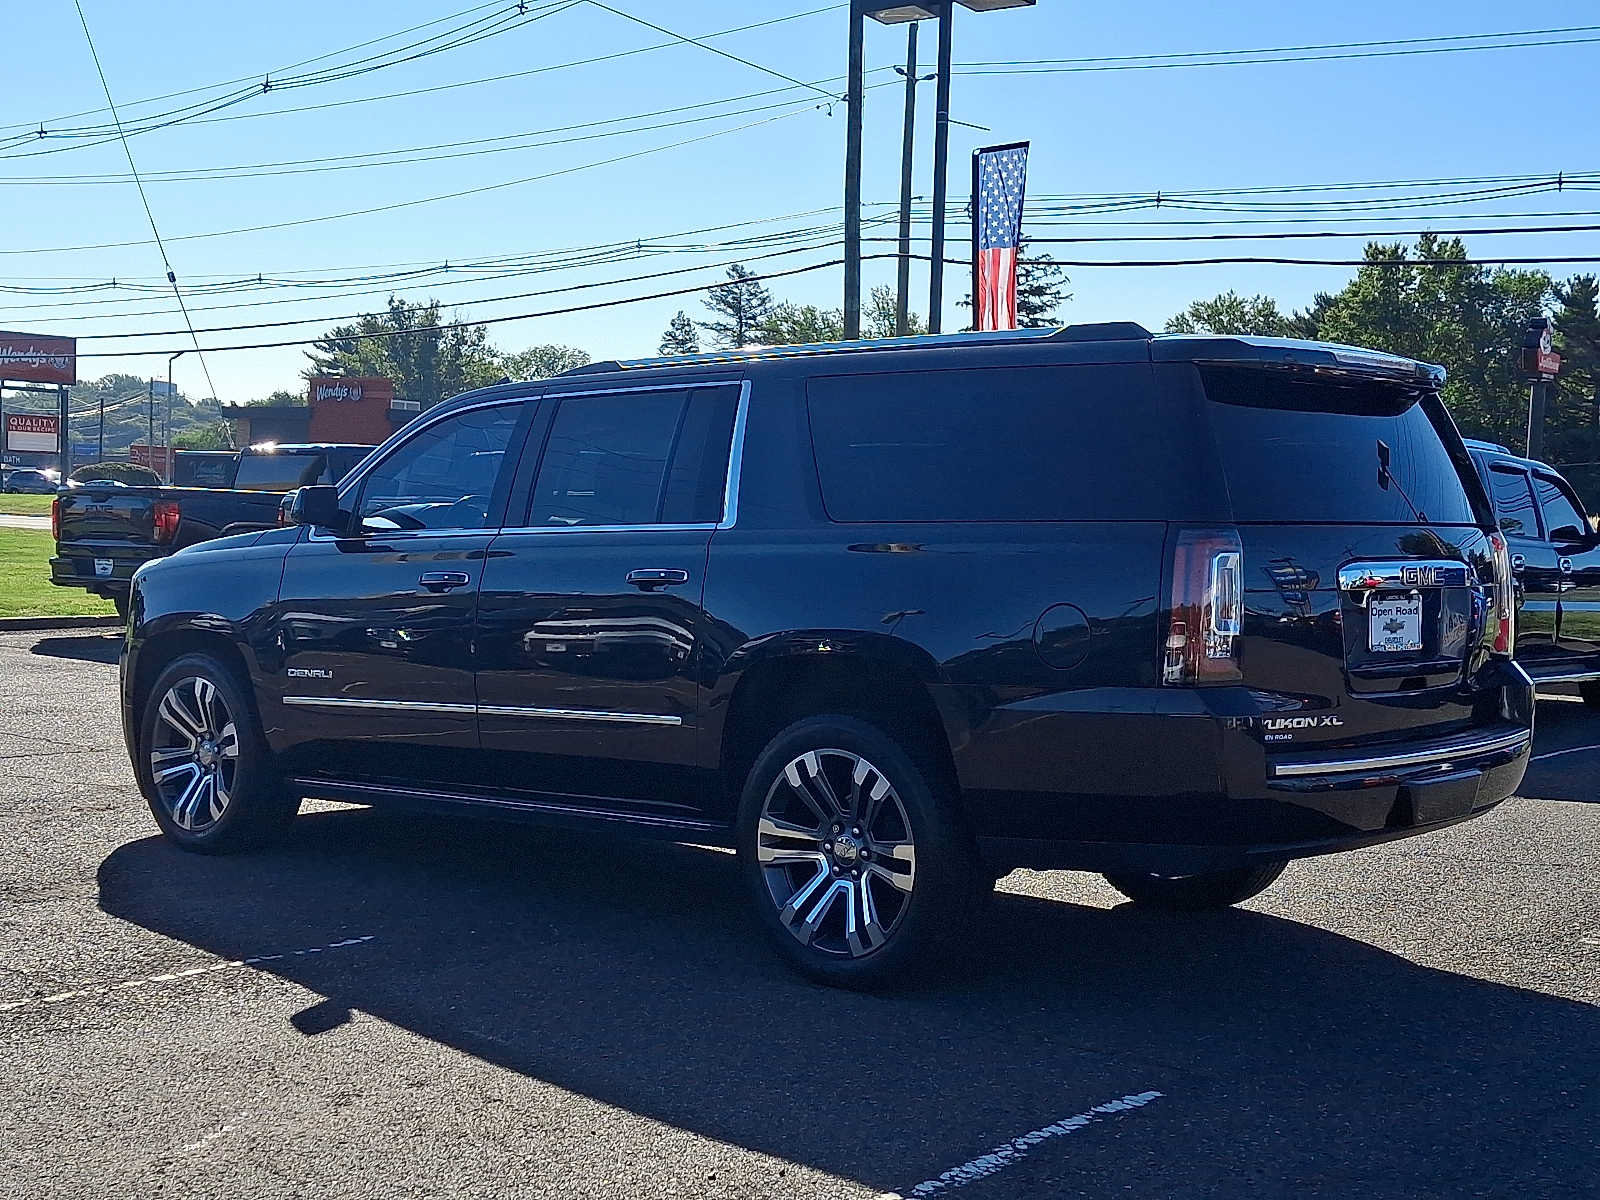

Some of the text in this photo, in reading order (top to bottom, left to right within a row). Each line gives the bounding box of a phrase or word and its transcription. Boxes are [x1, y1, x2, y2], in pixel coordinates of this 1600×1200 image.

[316, 382, 348, 401] Wendy's
[9, 417, 55, 427] QUALITY
[1402, 566, 1445, 586] GMC
[1372, 607, 1418, 618] Open Road
[287, 668, 333, 679] DENALI
[1261, 715, 1344, 730] YUKON XL
